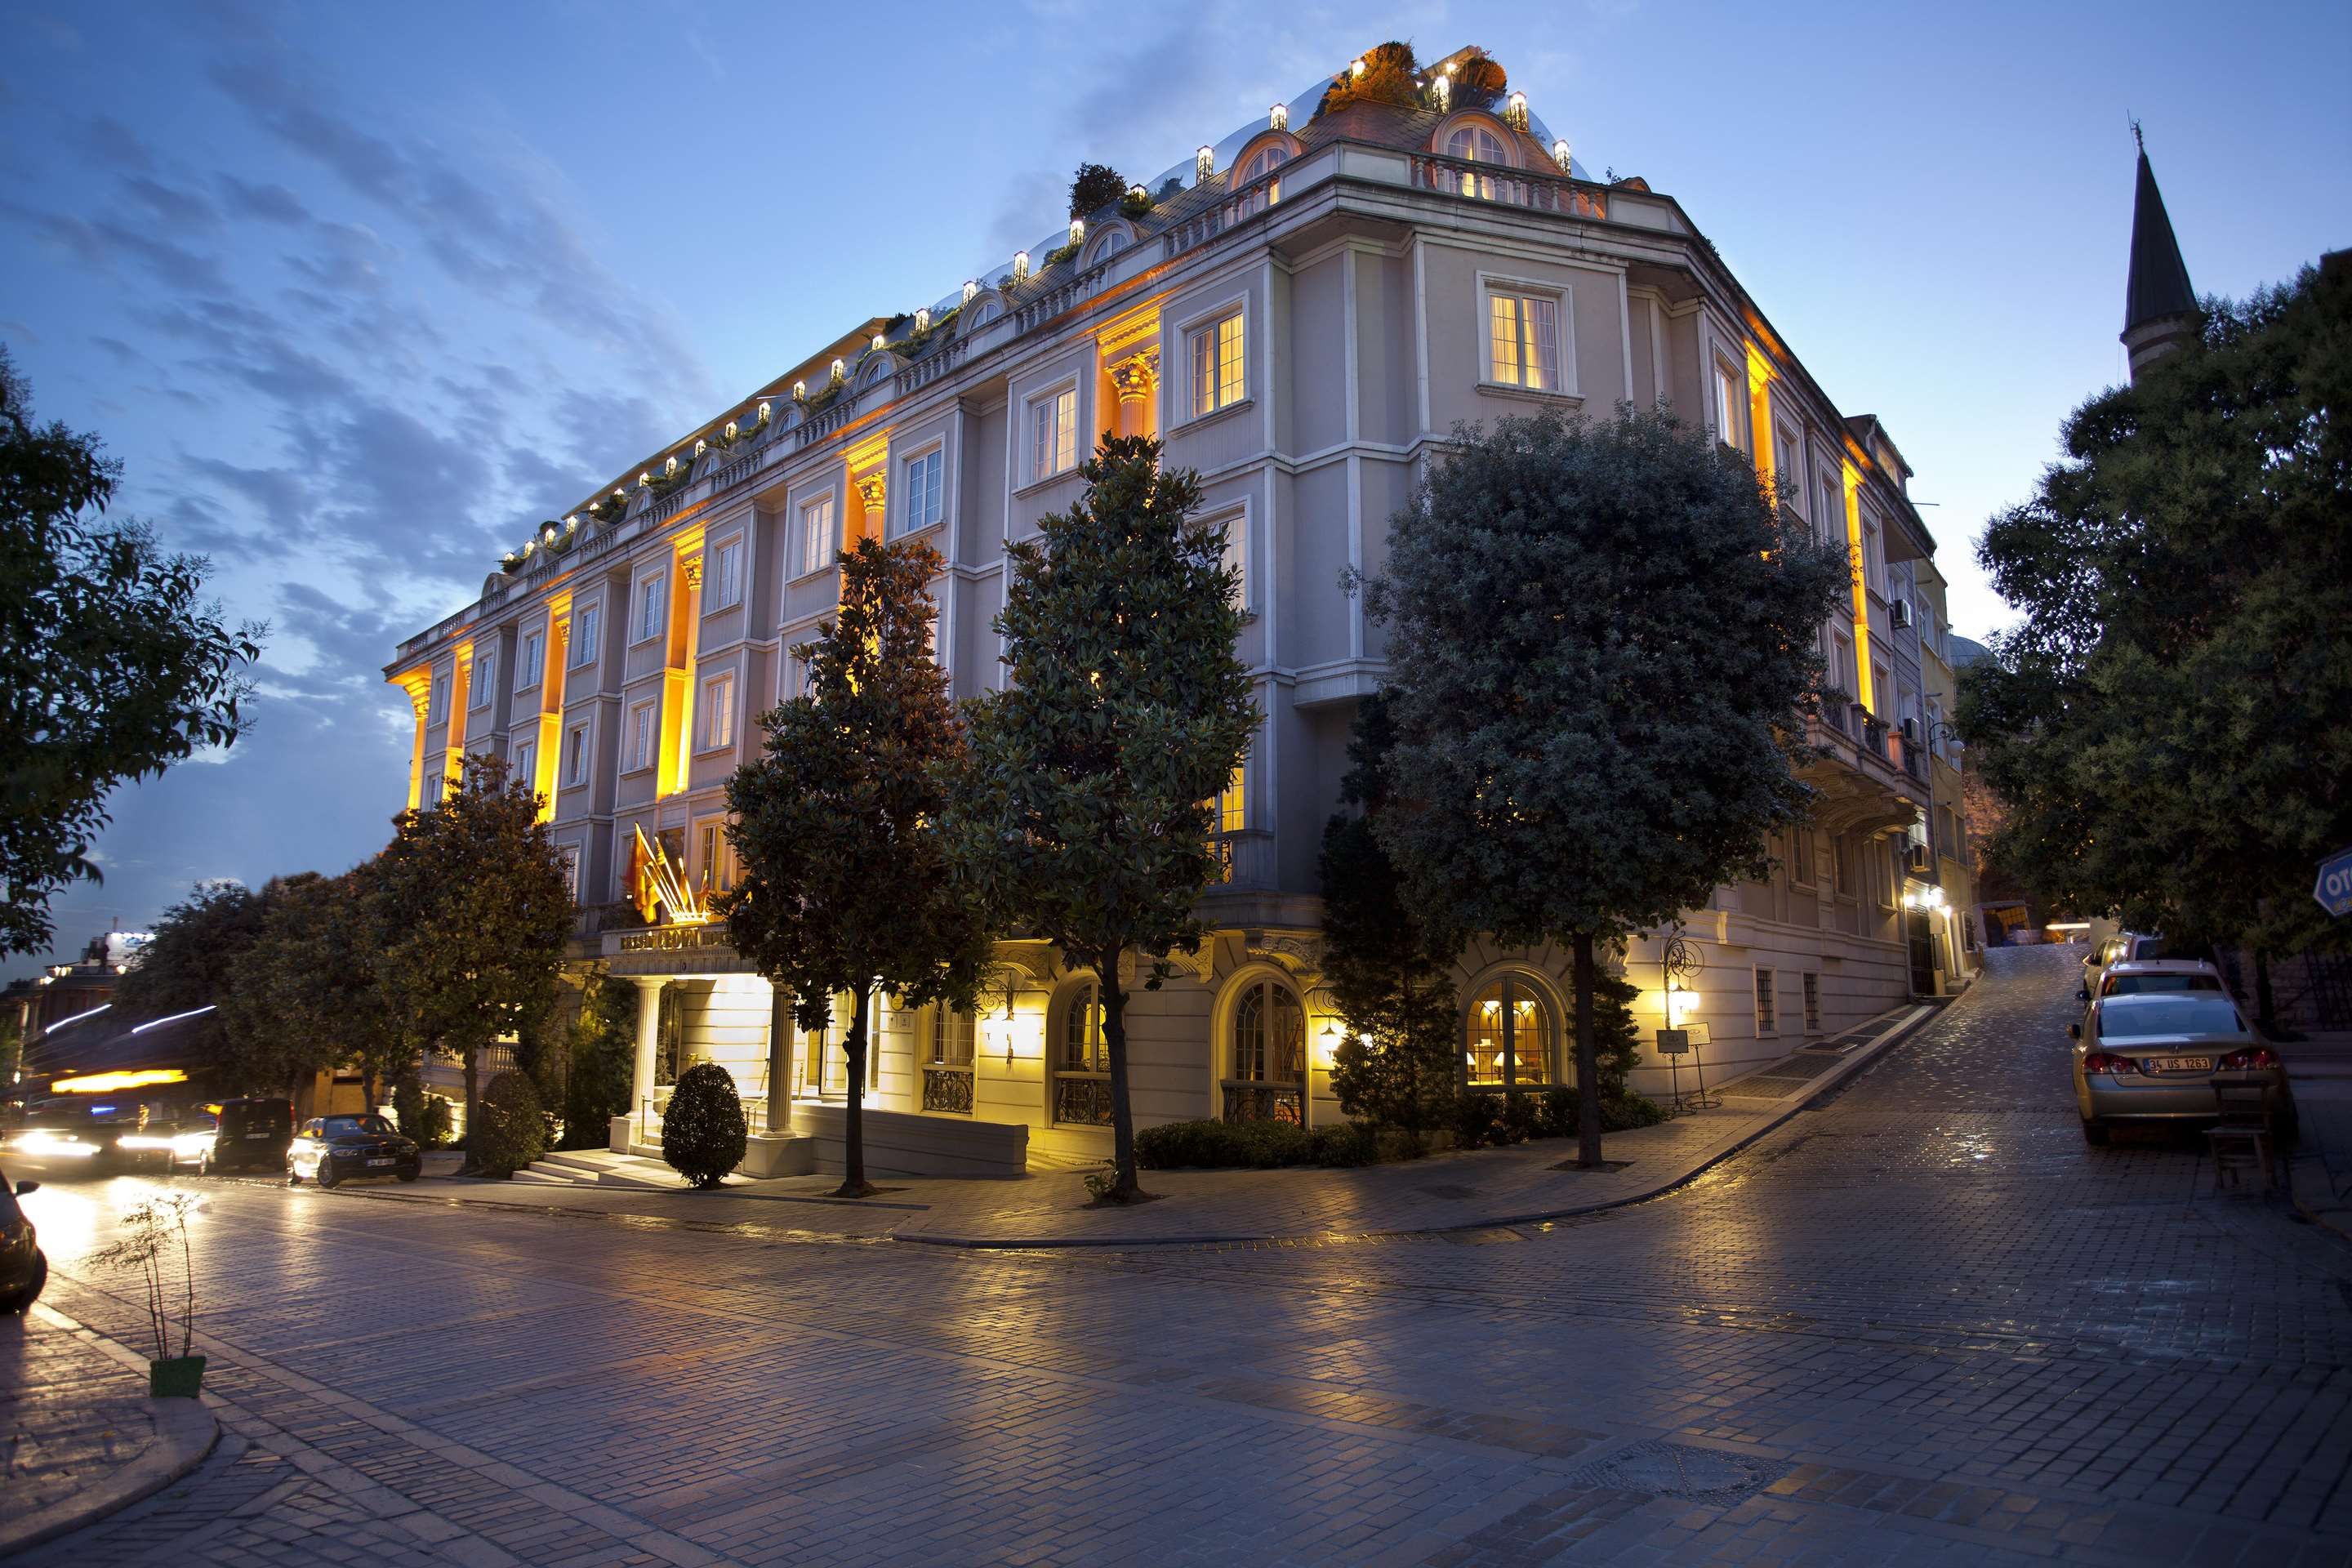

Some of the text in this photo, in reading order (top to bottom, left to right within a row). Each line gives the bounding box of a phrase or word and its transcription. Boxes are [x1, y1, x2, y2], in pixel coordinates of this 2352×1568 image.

[2325, 866, 2352, 896] OT
[657, 929, 700, 951] CROWN
[2149, 1058, 2208, 1070] 34 US 1263
